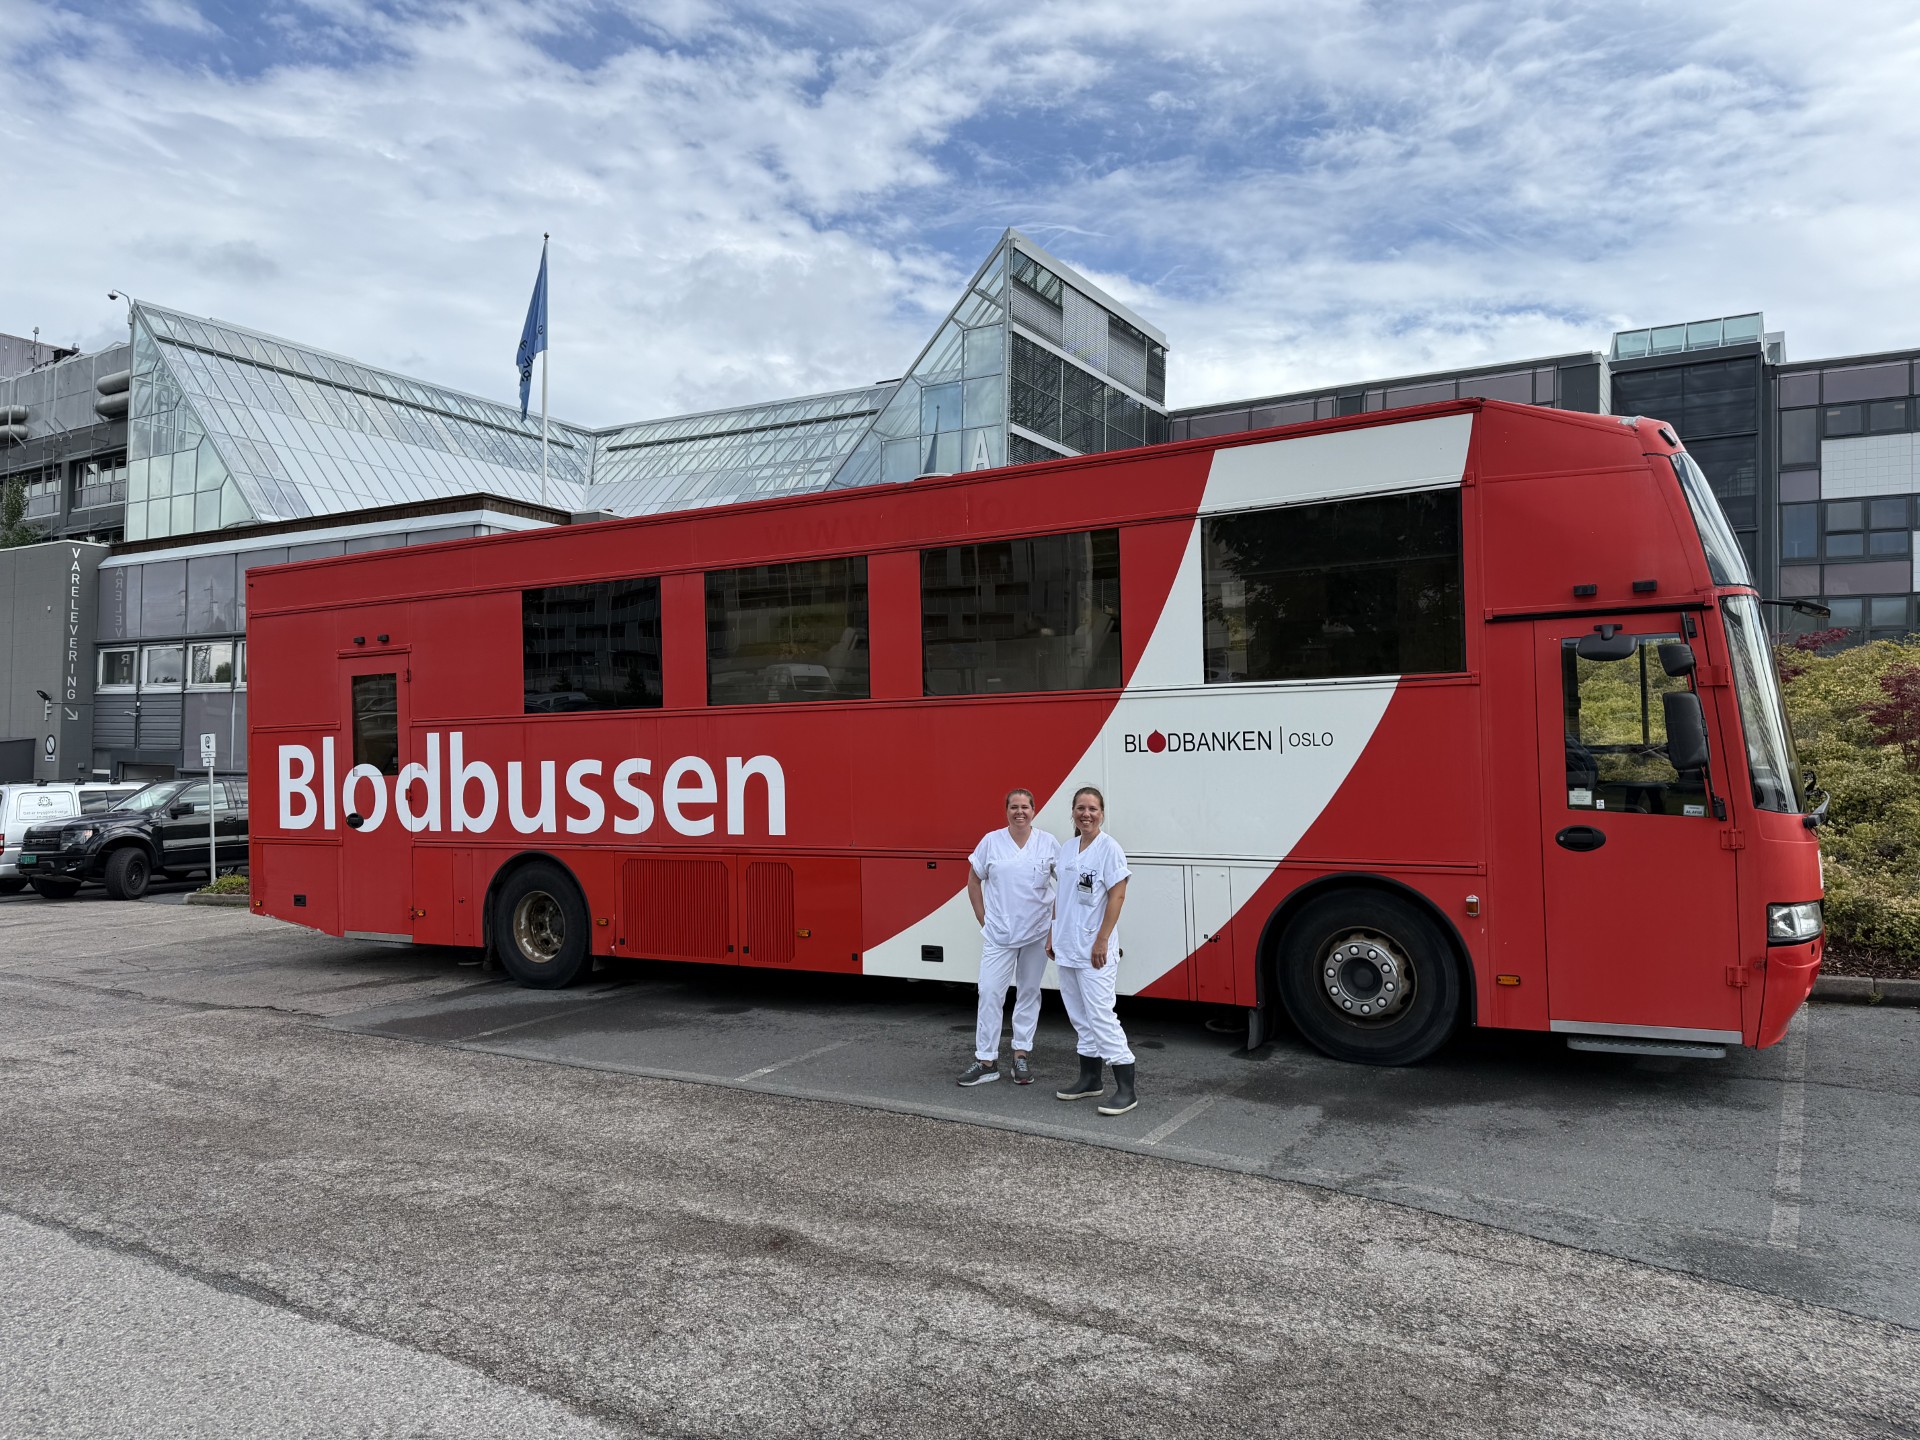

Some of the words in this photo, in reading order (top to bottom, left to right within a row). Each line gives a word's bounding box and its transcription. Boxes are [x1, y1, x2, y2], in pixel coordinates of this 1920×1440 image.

[67, 548, 81, 700] VARELEVERING
[278, 731, 787, 837] Blodbussen
[1288, 732, 1334, 747] OSLO
